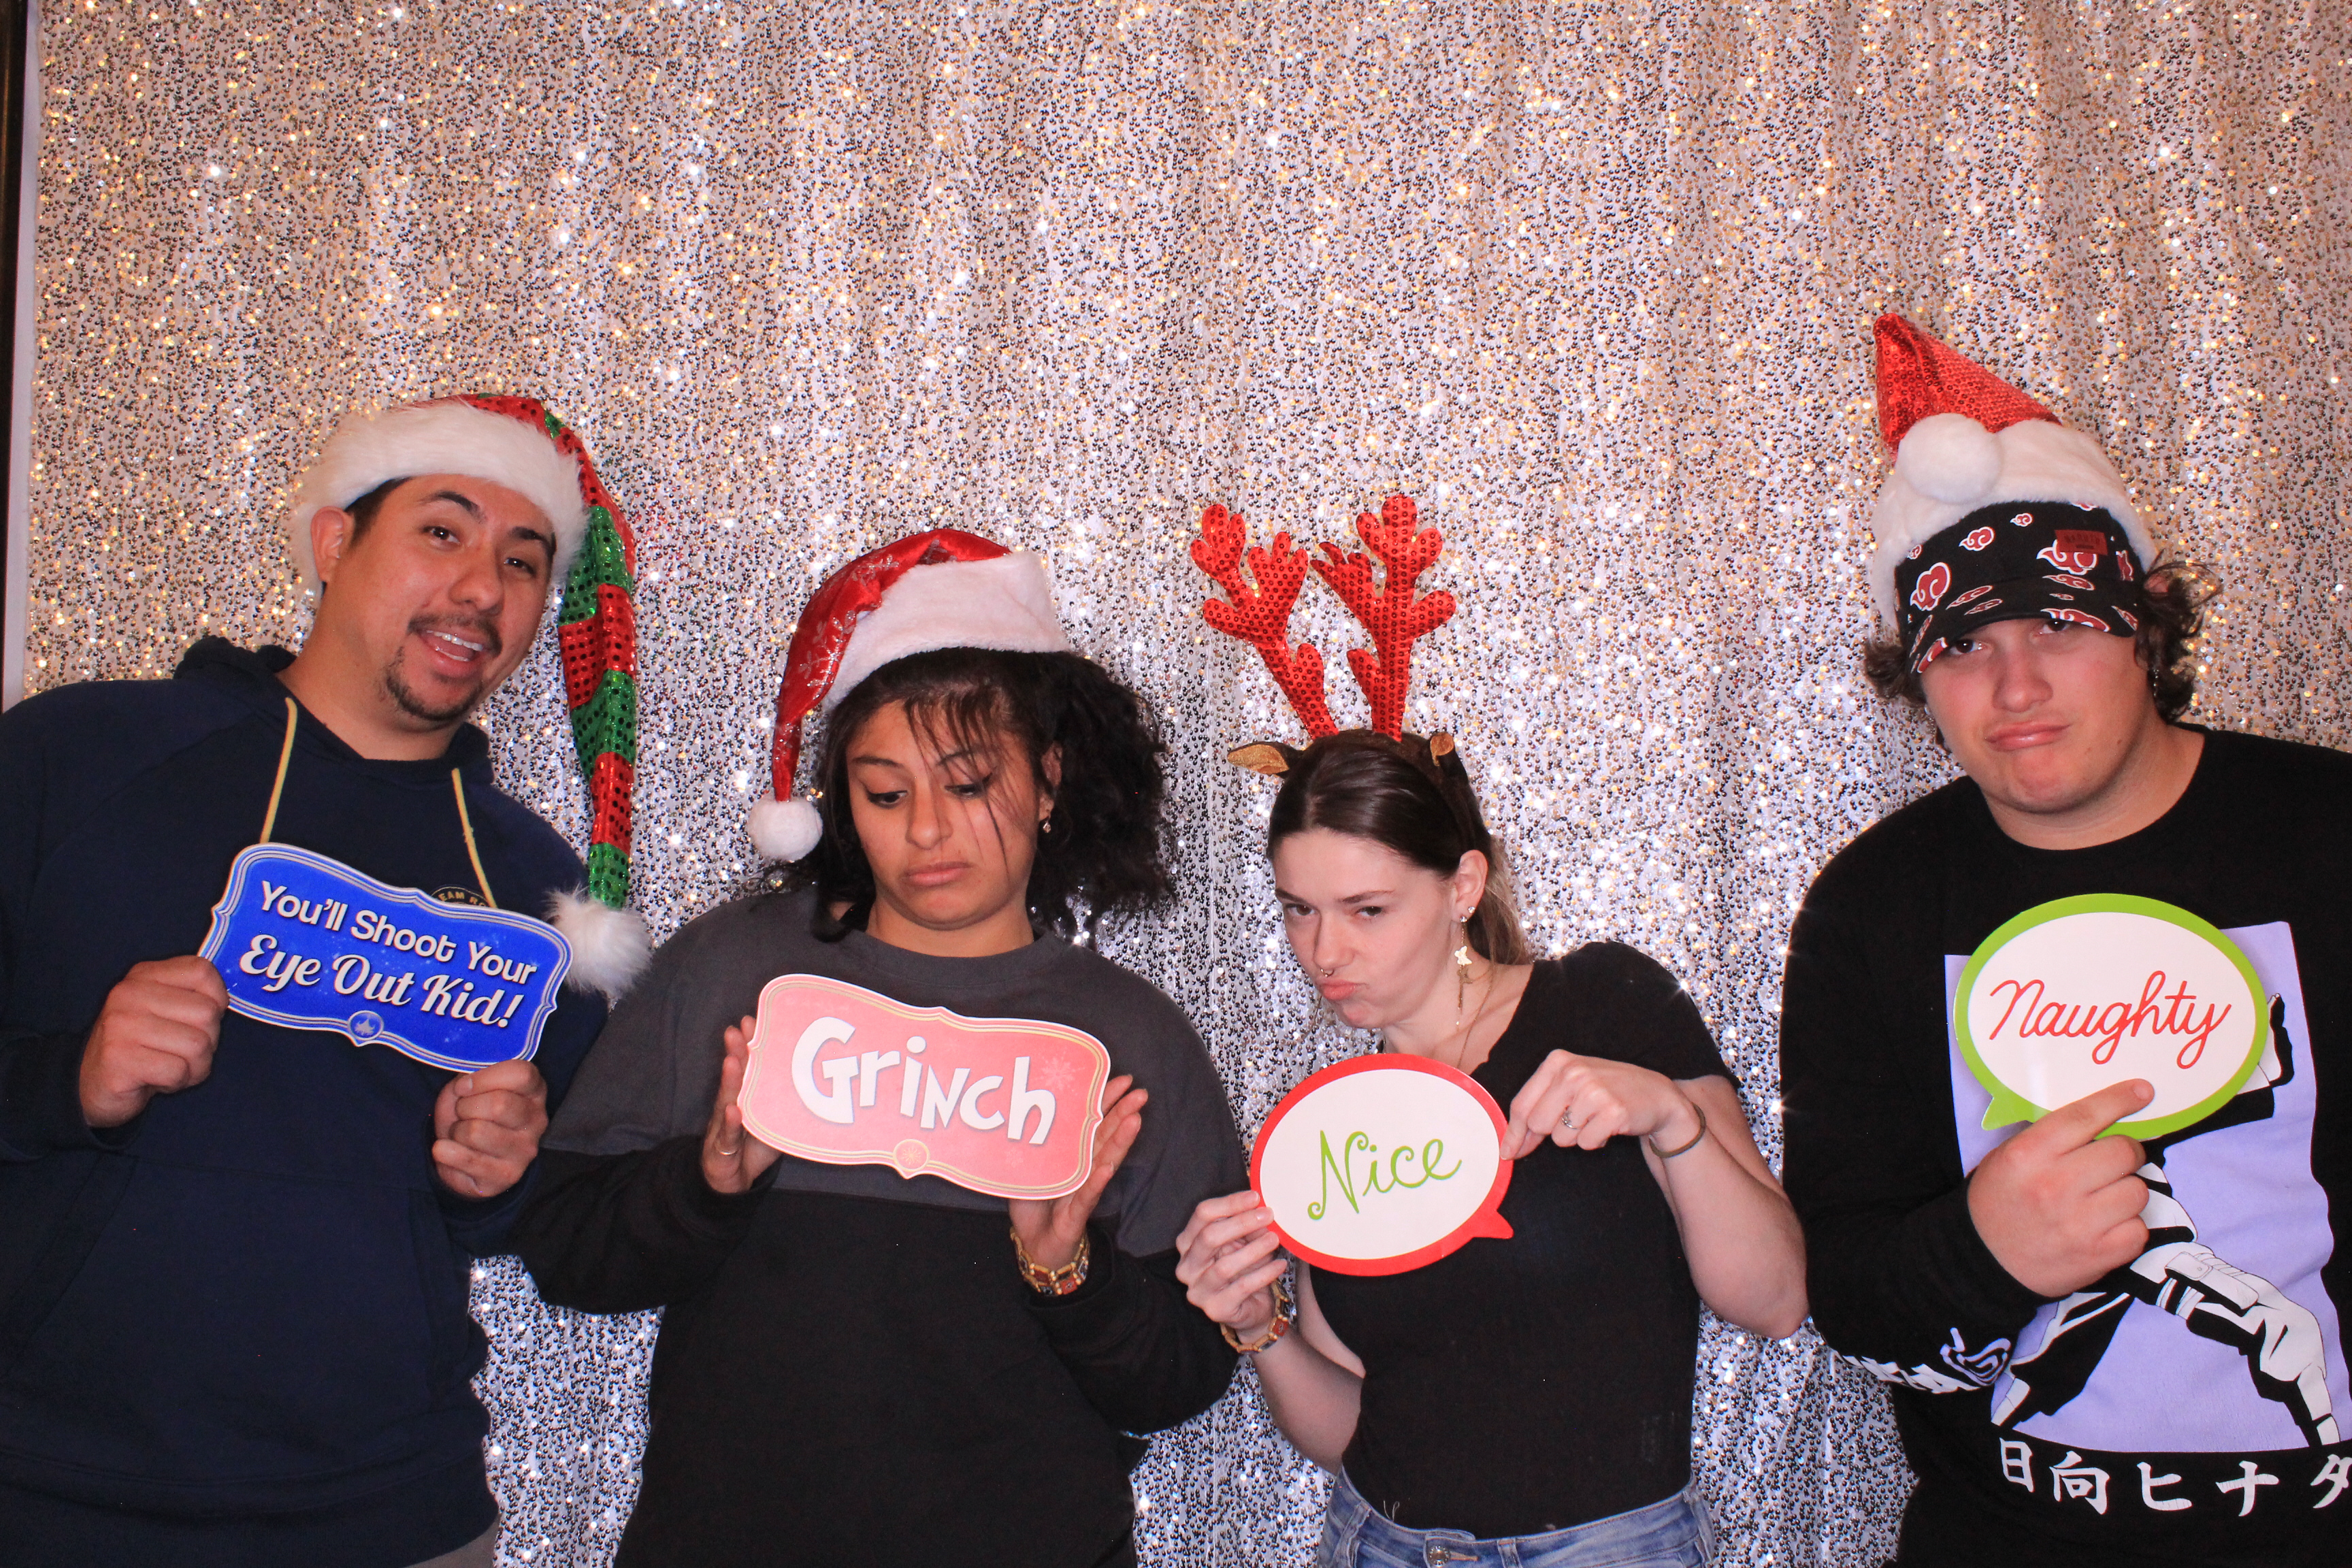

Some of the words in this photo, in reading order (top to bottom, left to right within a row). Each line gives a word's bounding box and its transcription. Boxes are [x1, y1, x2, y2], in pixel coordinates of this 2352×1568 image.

[261, 880, 348, 931] You'll
[350, 909, 457, 962] Shoot
[467, 941, 538, 985] Your
[438, 891, 465, 902] EAM
[239, 934, 323, 992] Eye
[331, 954, 415, 1007] Out
[420, 974, 525, 1029] Kid!
[1989, 970, 2232, 1069] Naughty
[1307, 1130, 1463, 1221] Nice
